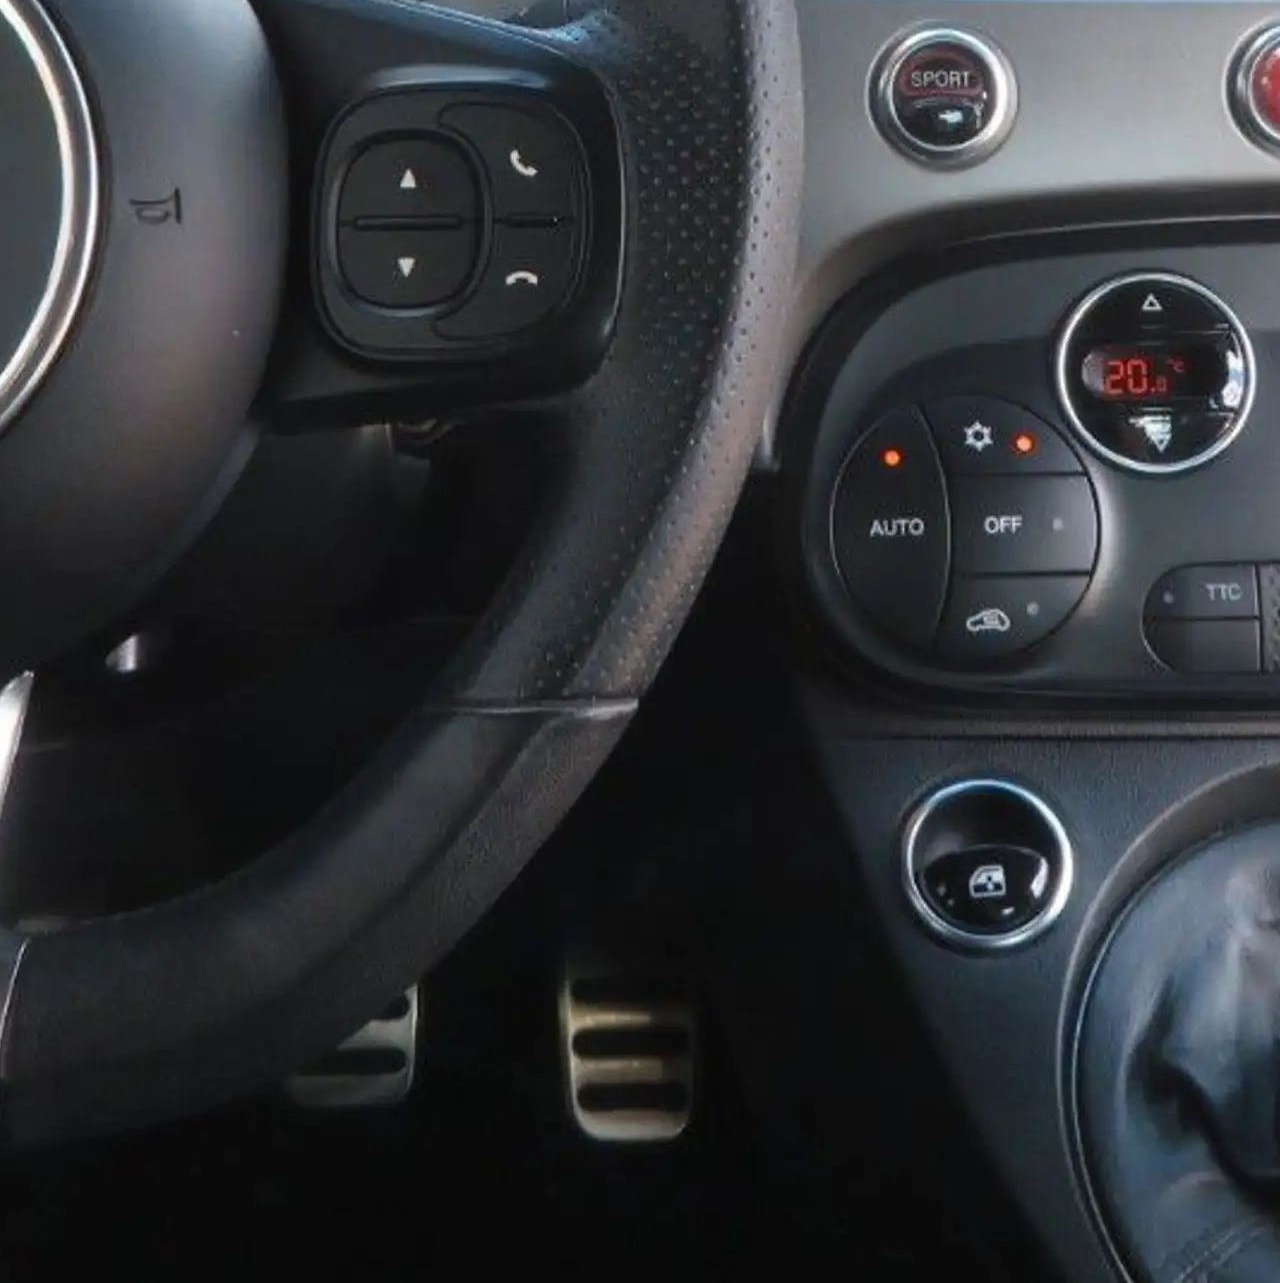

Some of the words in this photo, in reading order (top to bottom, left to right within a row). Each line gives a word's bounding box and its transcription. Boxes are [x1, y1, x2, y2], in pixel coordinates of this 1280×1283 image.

[911, 71, 970, 88] SPORT
[870, 518, 924, 537] AUTO
[984, 515, 1023, 534] OFF
[1205, 583, 1242, 602] TTC
